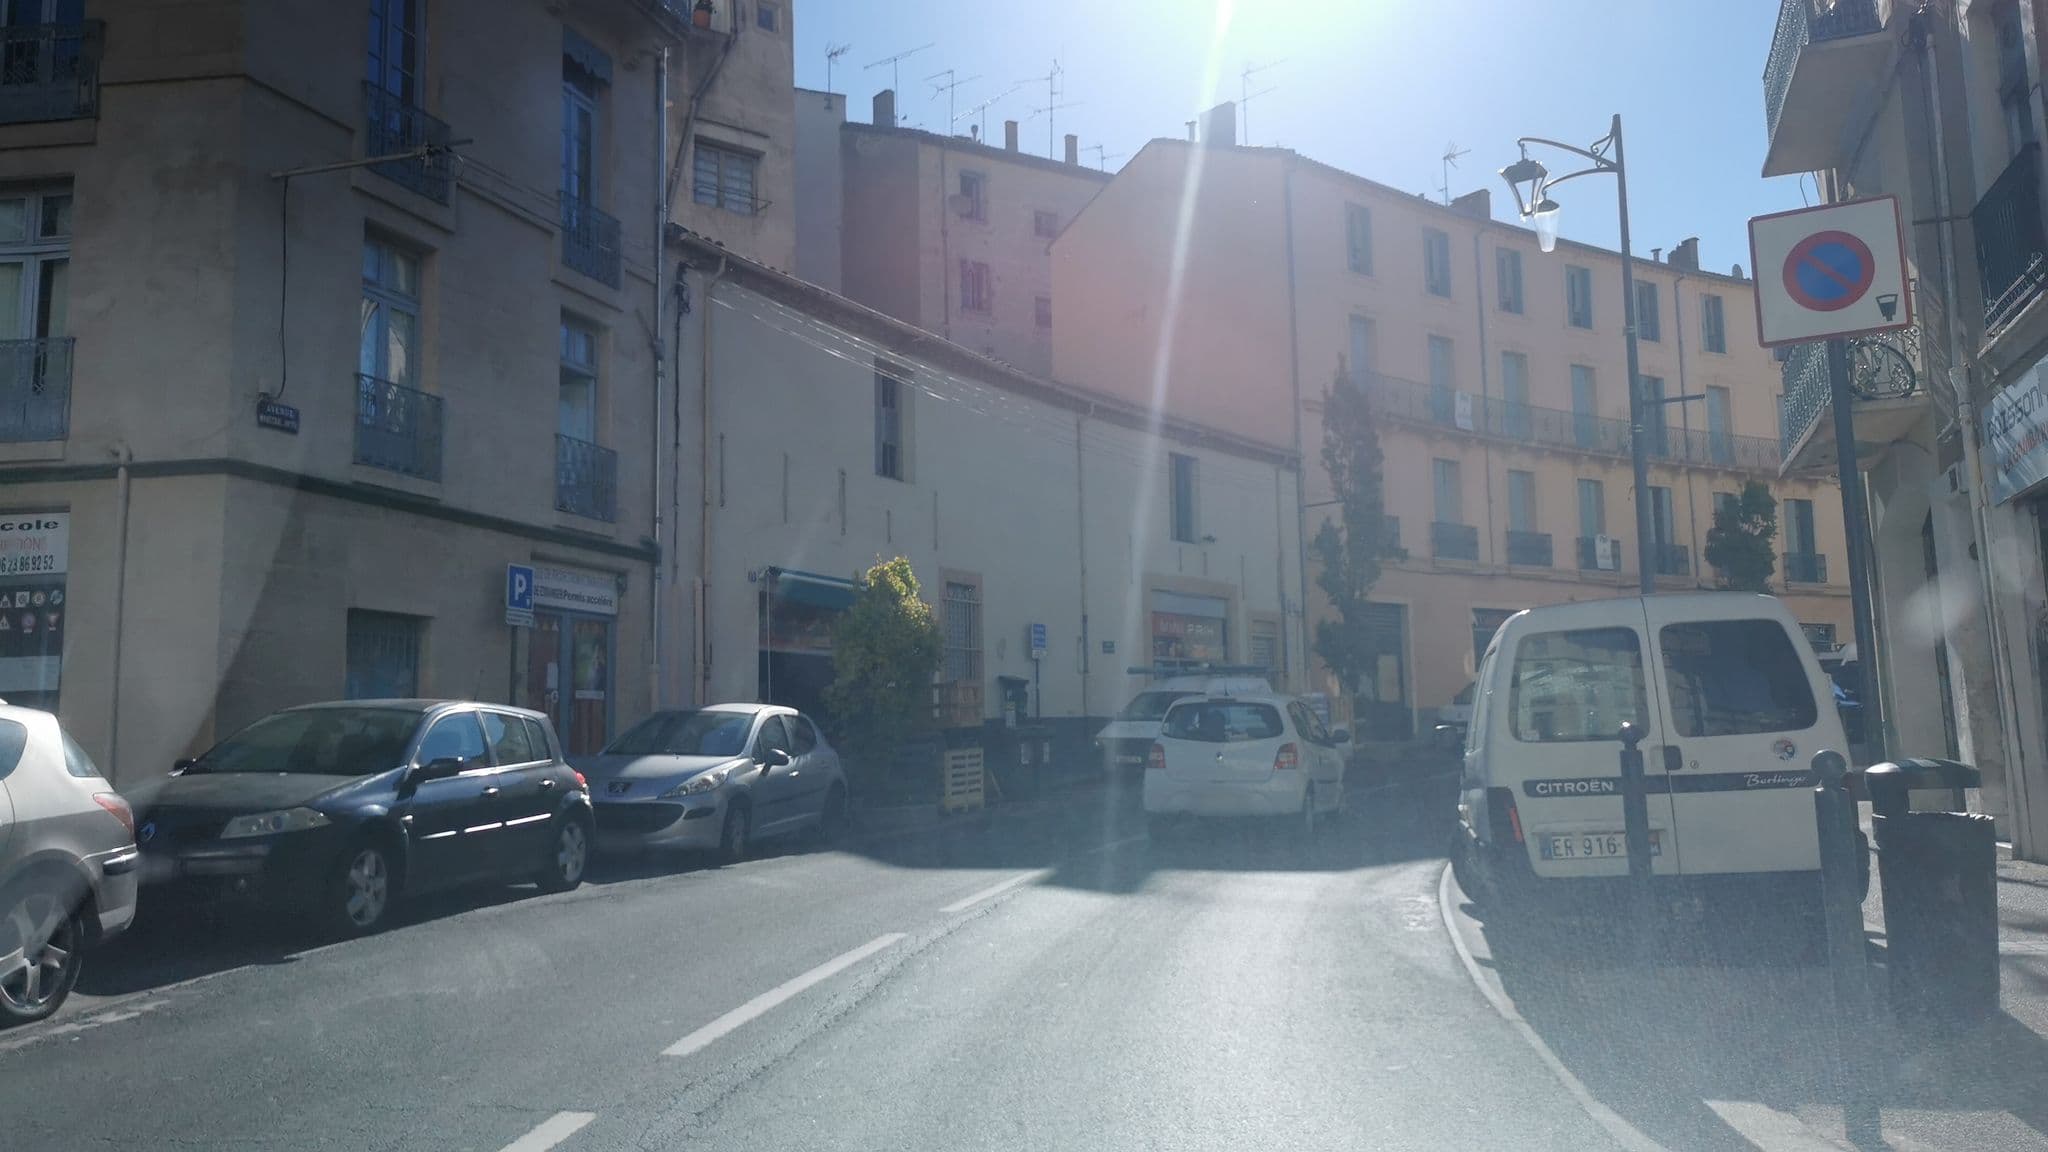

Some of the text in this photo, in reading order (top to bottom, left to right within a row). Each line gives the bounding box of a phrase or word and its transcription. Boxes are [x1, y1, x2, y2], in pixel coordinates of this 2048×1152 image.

[19, 556, 30, 571] 86
[31, 555, 41, 570] 92
[43, 555, 54, 570] 52
[514, 573, 526, 600] P
[1535, 779, 1615, 795] CITROËN
